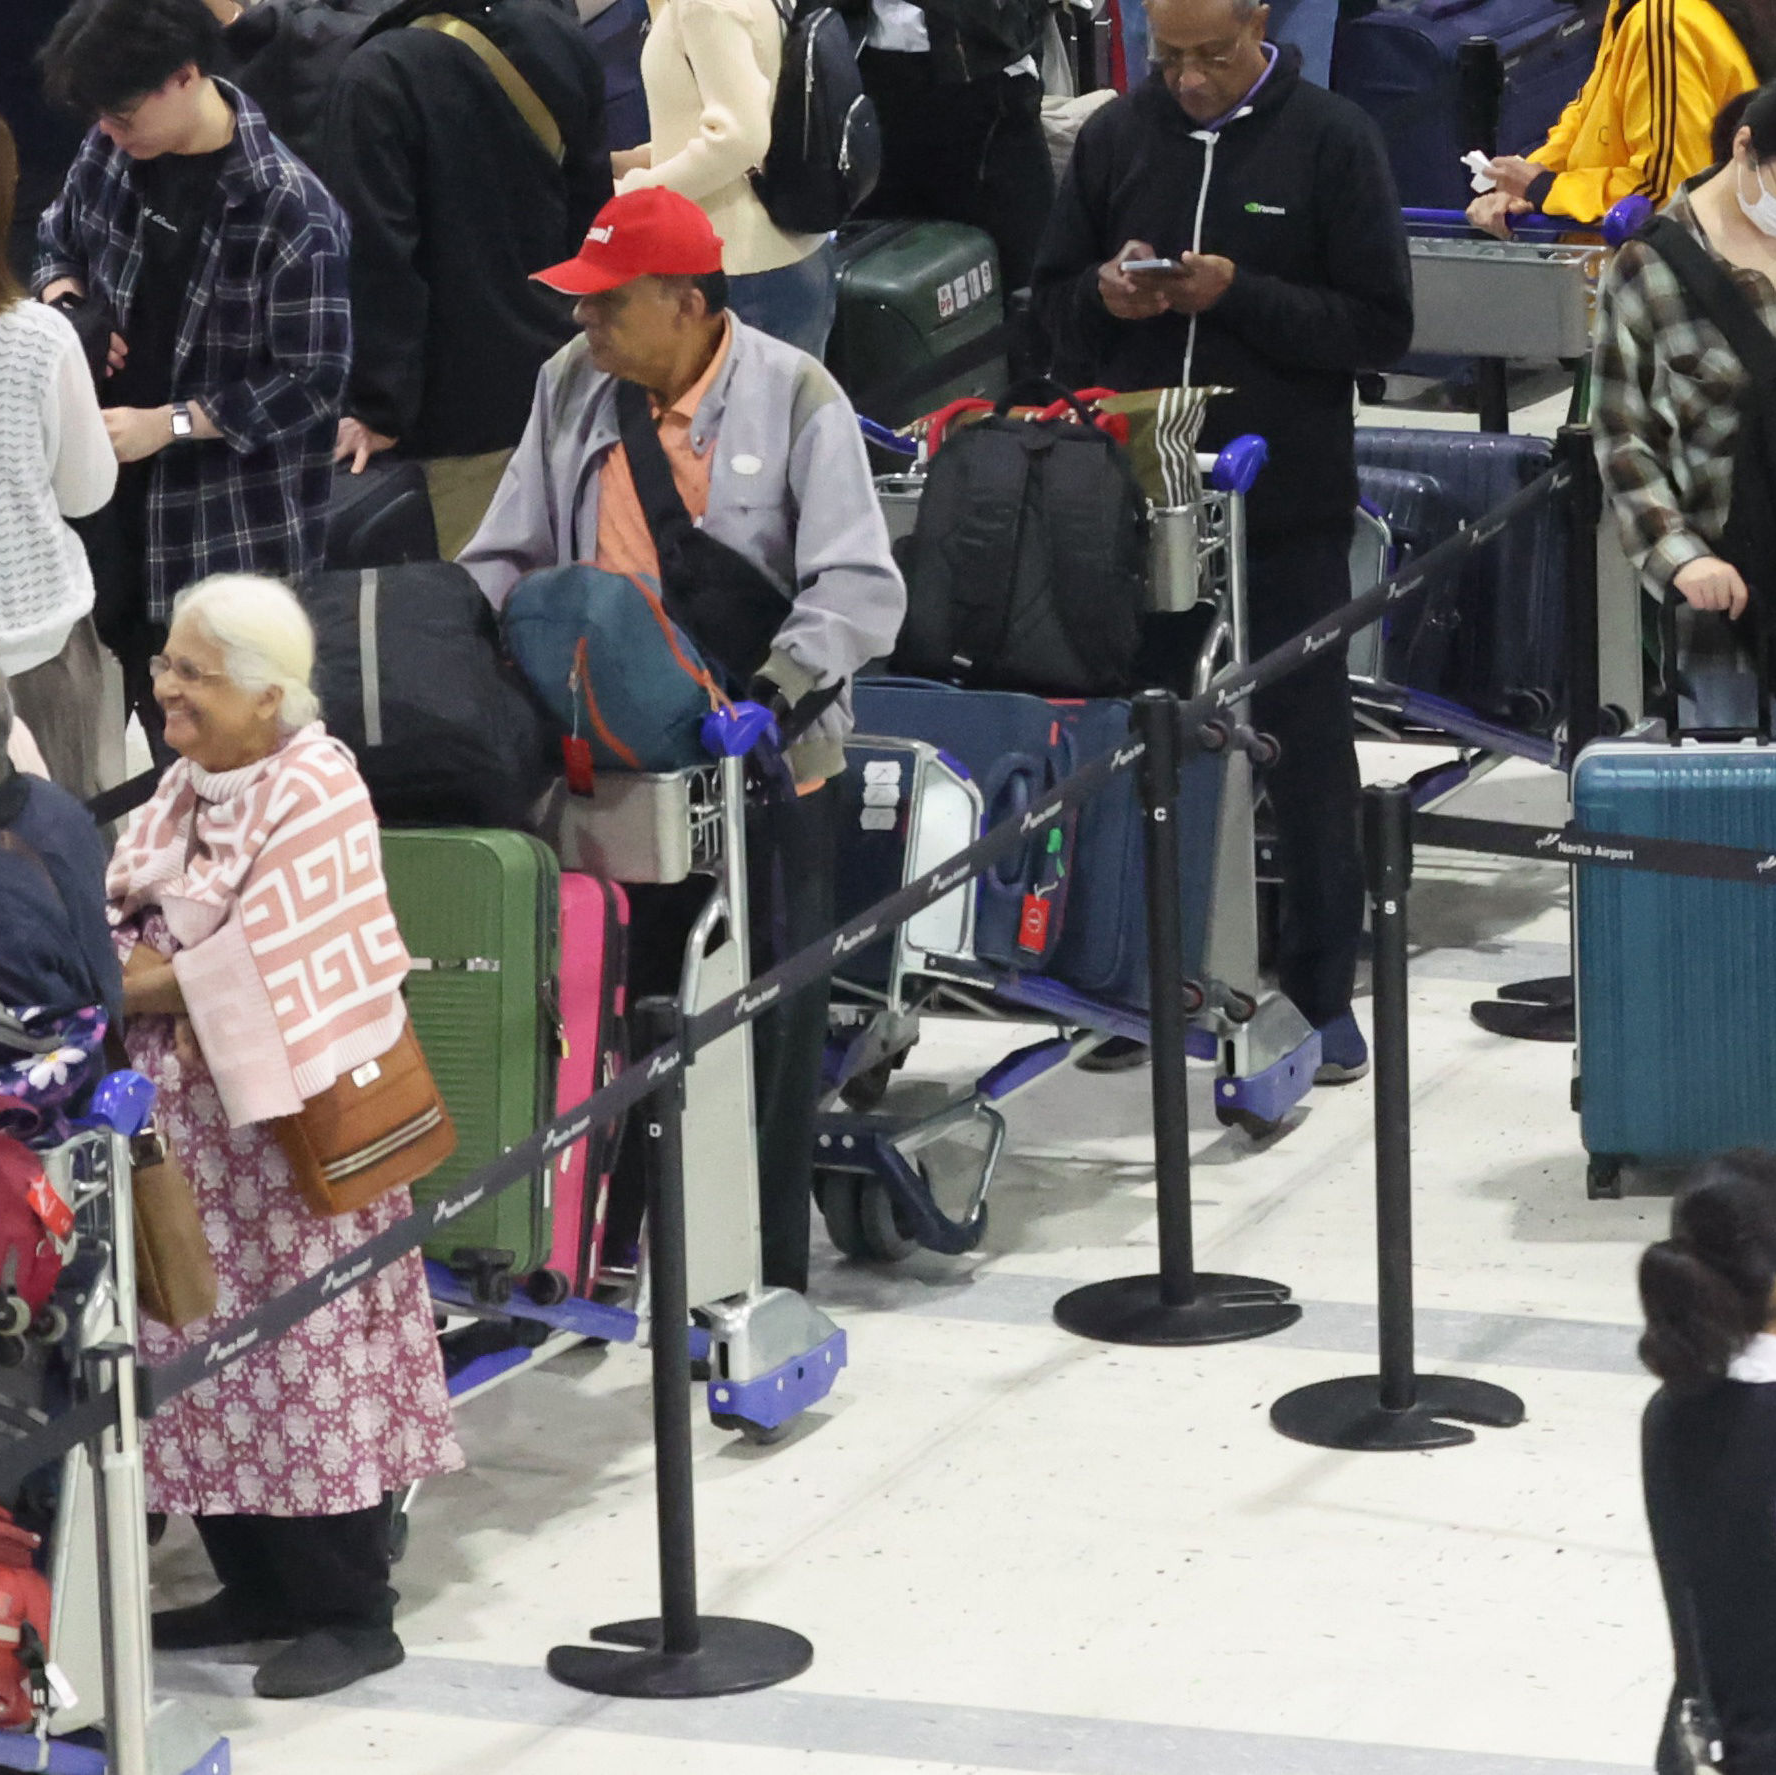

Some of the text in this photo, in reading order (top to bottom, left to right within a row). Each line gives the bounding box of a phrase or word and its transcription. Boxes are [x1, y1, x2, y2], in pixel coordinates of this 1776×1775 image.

[1154, 807, 1167, 822] C
[1558, 841, 1634, 861] Narita Airport
[1385, 901, 1396, 915] S
